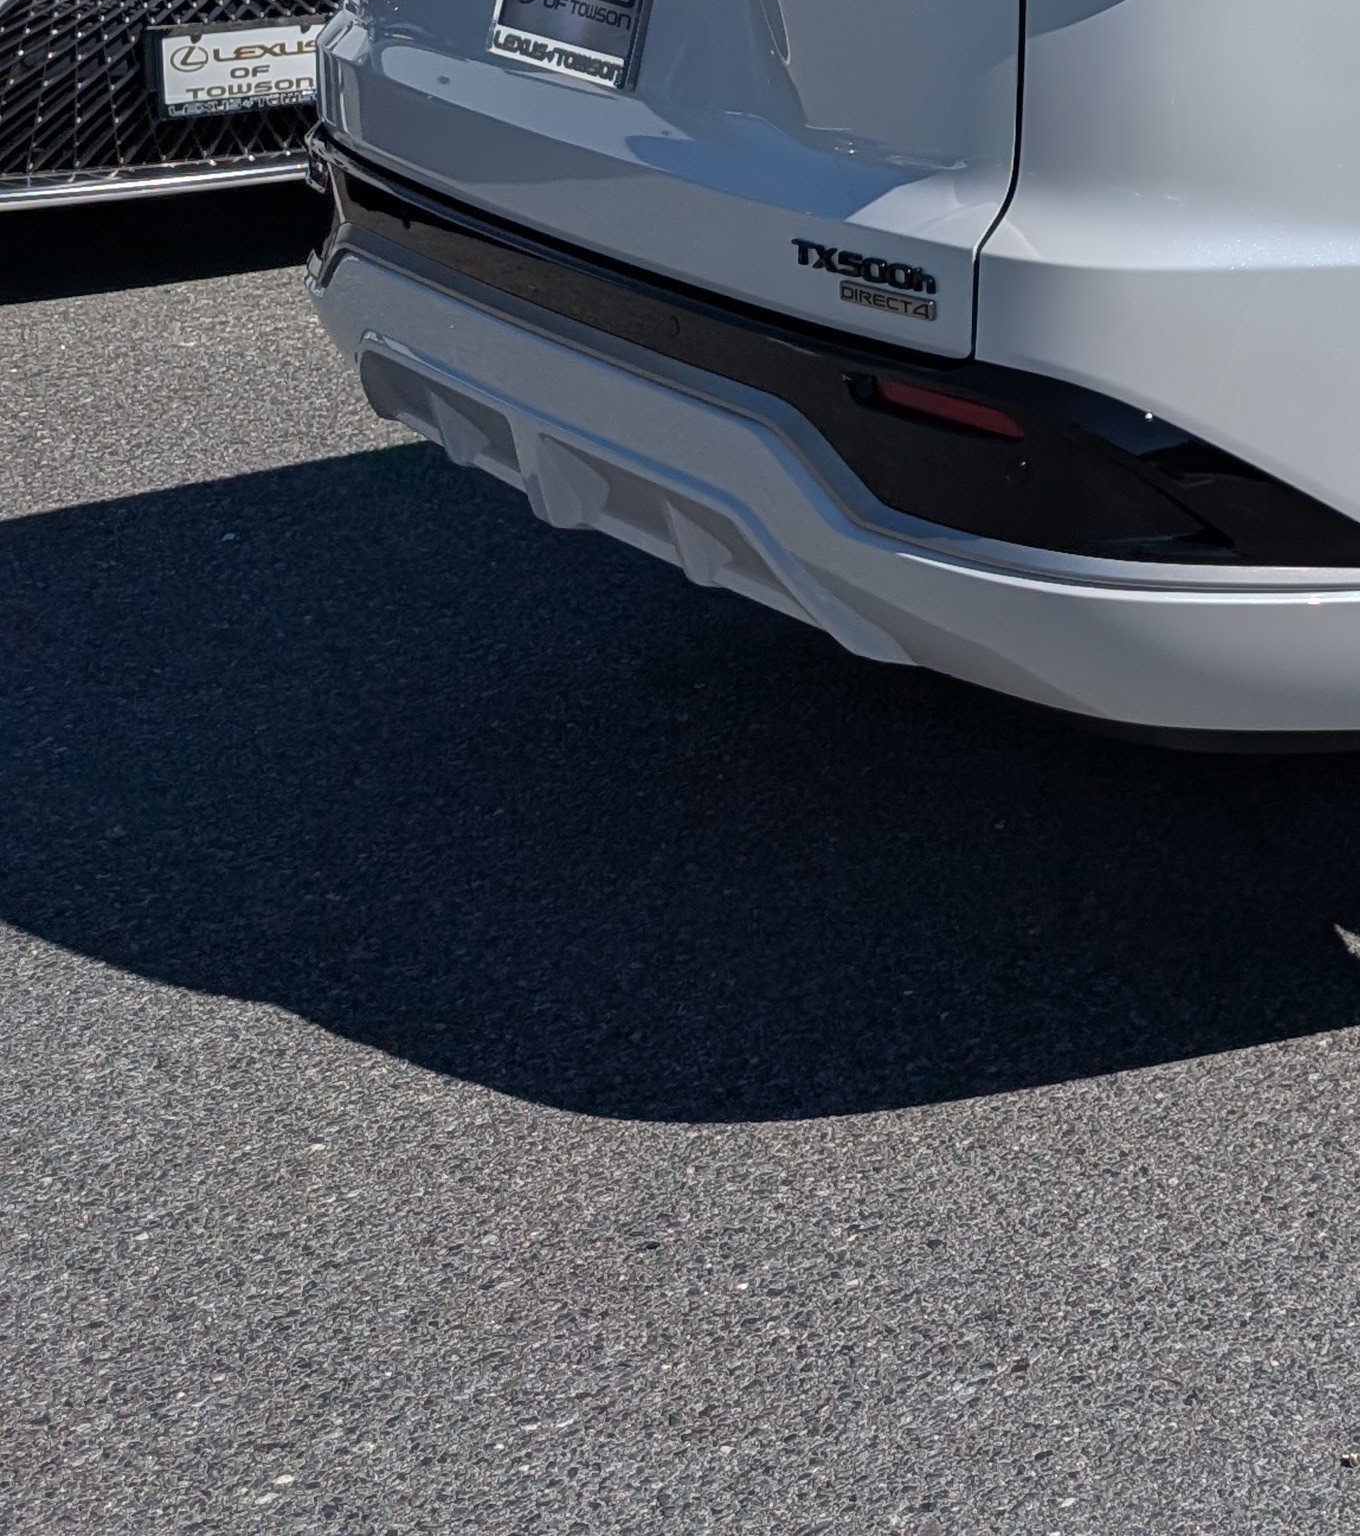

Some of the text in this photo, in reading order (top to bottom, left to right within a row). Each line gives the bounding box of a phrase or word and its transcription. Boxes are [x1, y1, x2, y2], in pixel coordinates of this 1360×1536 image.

[570, 0, 632, 30] TOWSON
[494, 29, 549, 63] LEXUS
[230, 64, 271, 79] OF
[186, 76, 315, 100] TOWSON
[841, 285, 930, 320] DIRECT4
